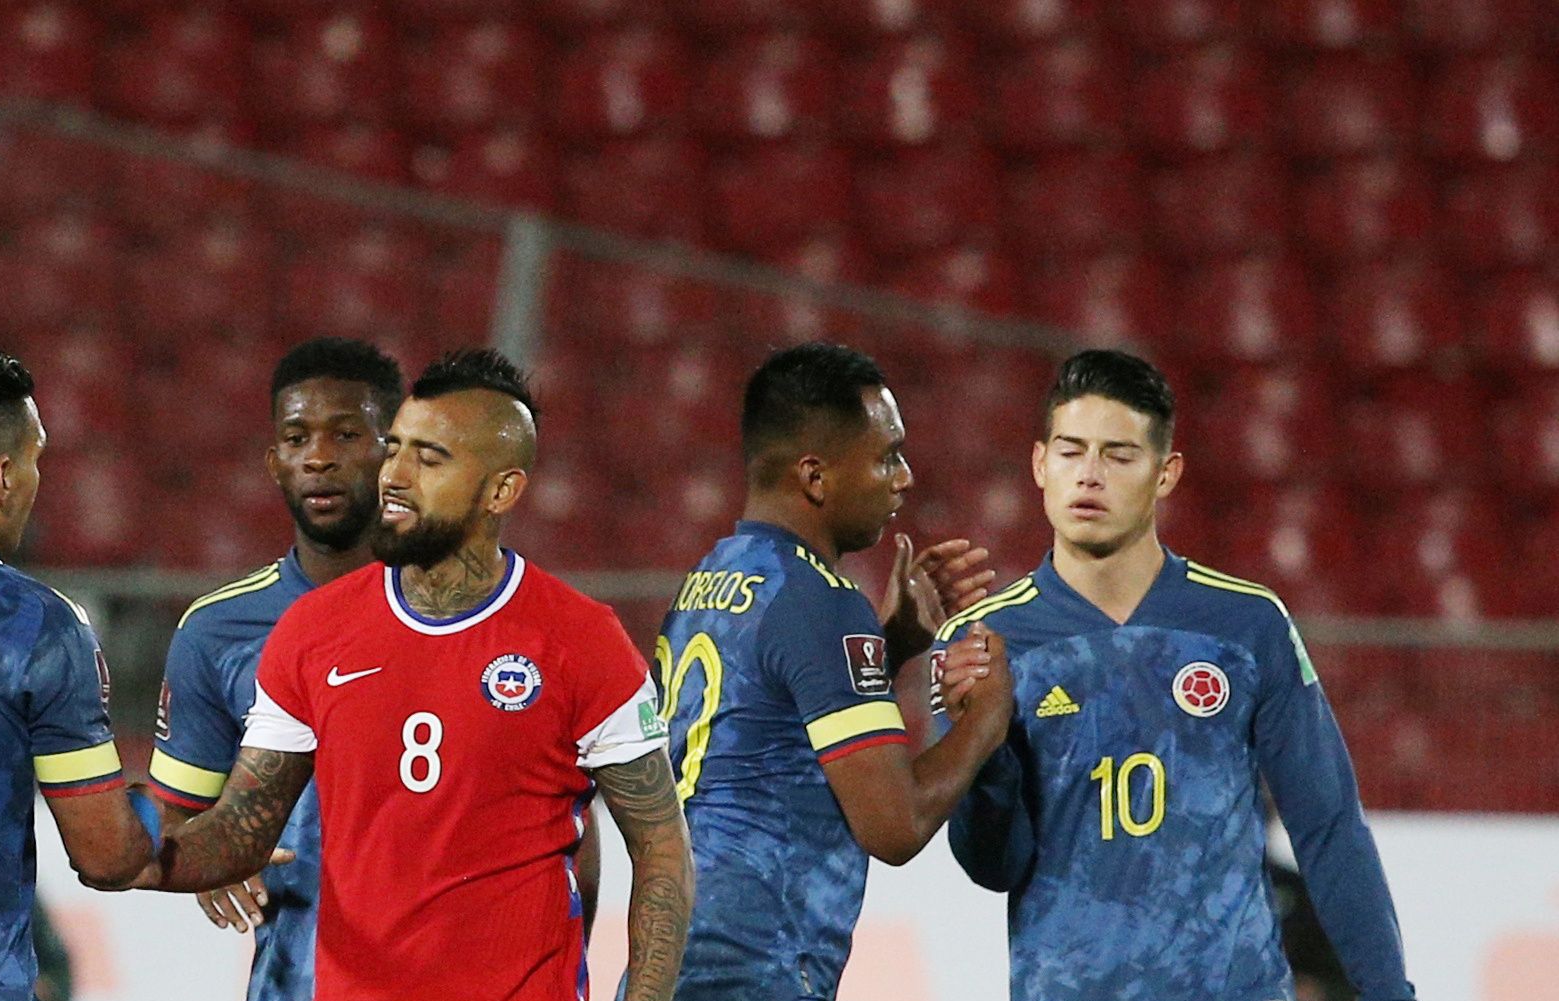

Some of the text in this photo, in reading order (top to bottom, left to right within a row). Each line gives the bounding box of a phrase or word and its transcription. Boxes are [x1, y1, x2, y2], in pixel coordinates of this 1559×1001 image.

[675, 570, 765, 614] ORELOS
[1036, 703, 1080, 718] adidas
[399, 711, 443, 793] 8
[1091, 753, 1166, 840] 10
